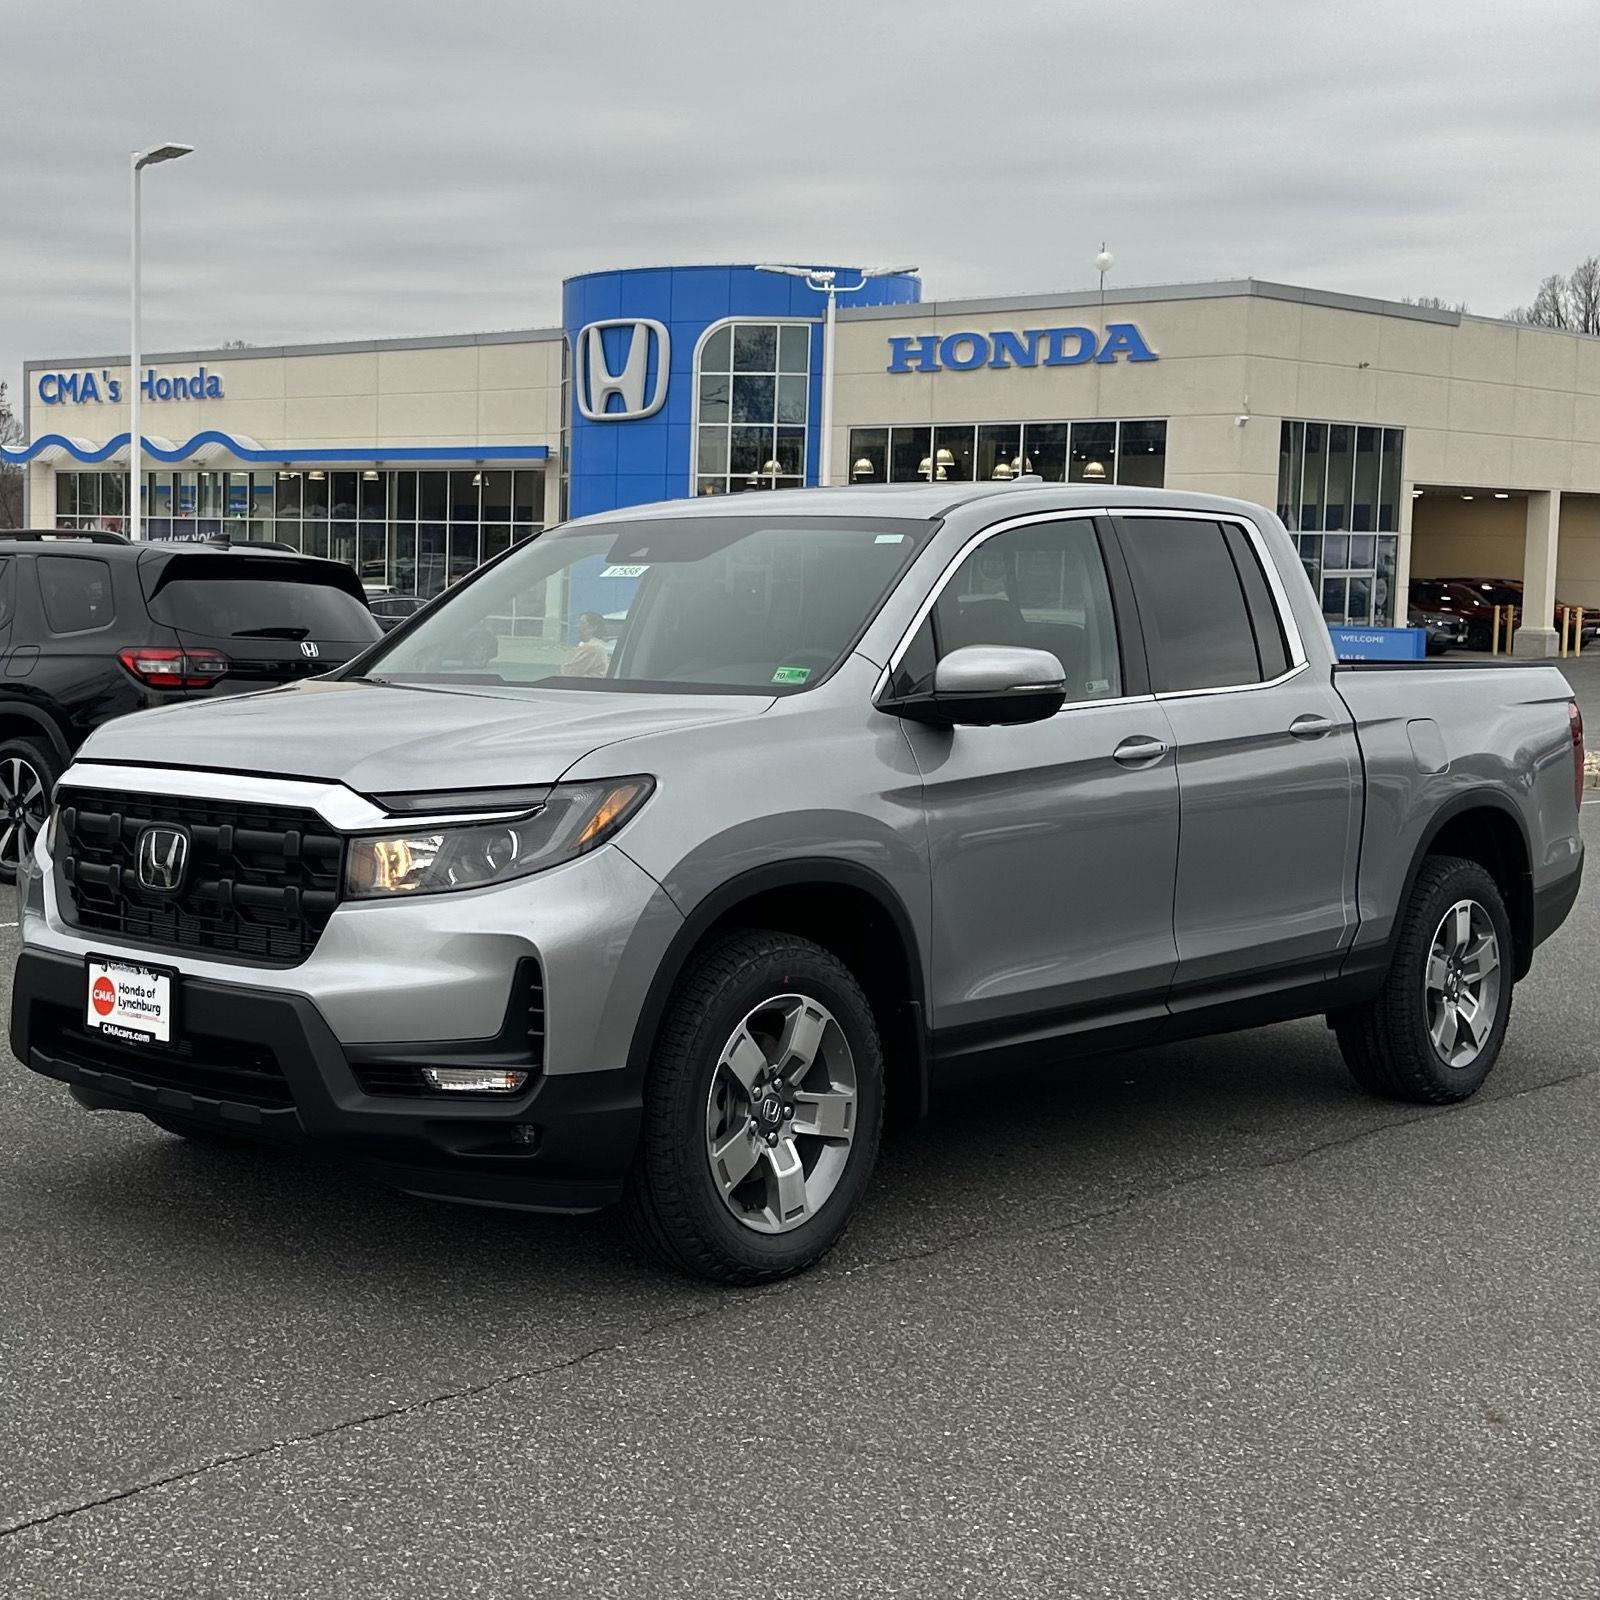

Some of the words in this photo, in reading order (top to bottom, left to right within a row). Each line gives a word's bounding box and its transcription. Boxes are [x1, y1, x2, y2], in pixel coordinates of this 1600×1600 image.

[887, 323, 1159, 373] HONDA
[39, 370, 122, 405] CMA's
[1341, 635, 1384, 644] WELCOME
[118, 982, 145, 998] Honda
[146, 988, 156, 999] of
[118, 996, 161, 1016] Lynchburg
[102, 1023, 151, 1043] CMAcars.com
